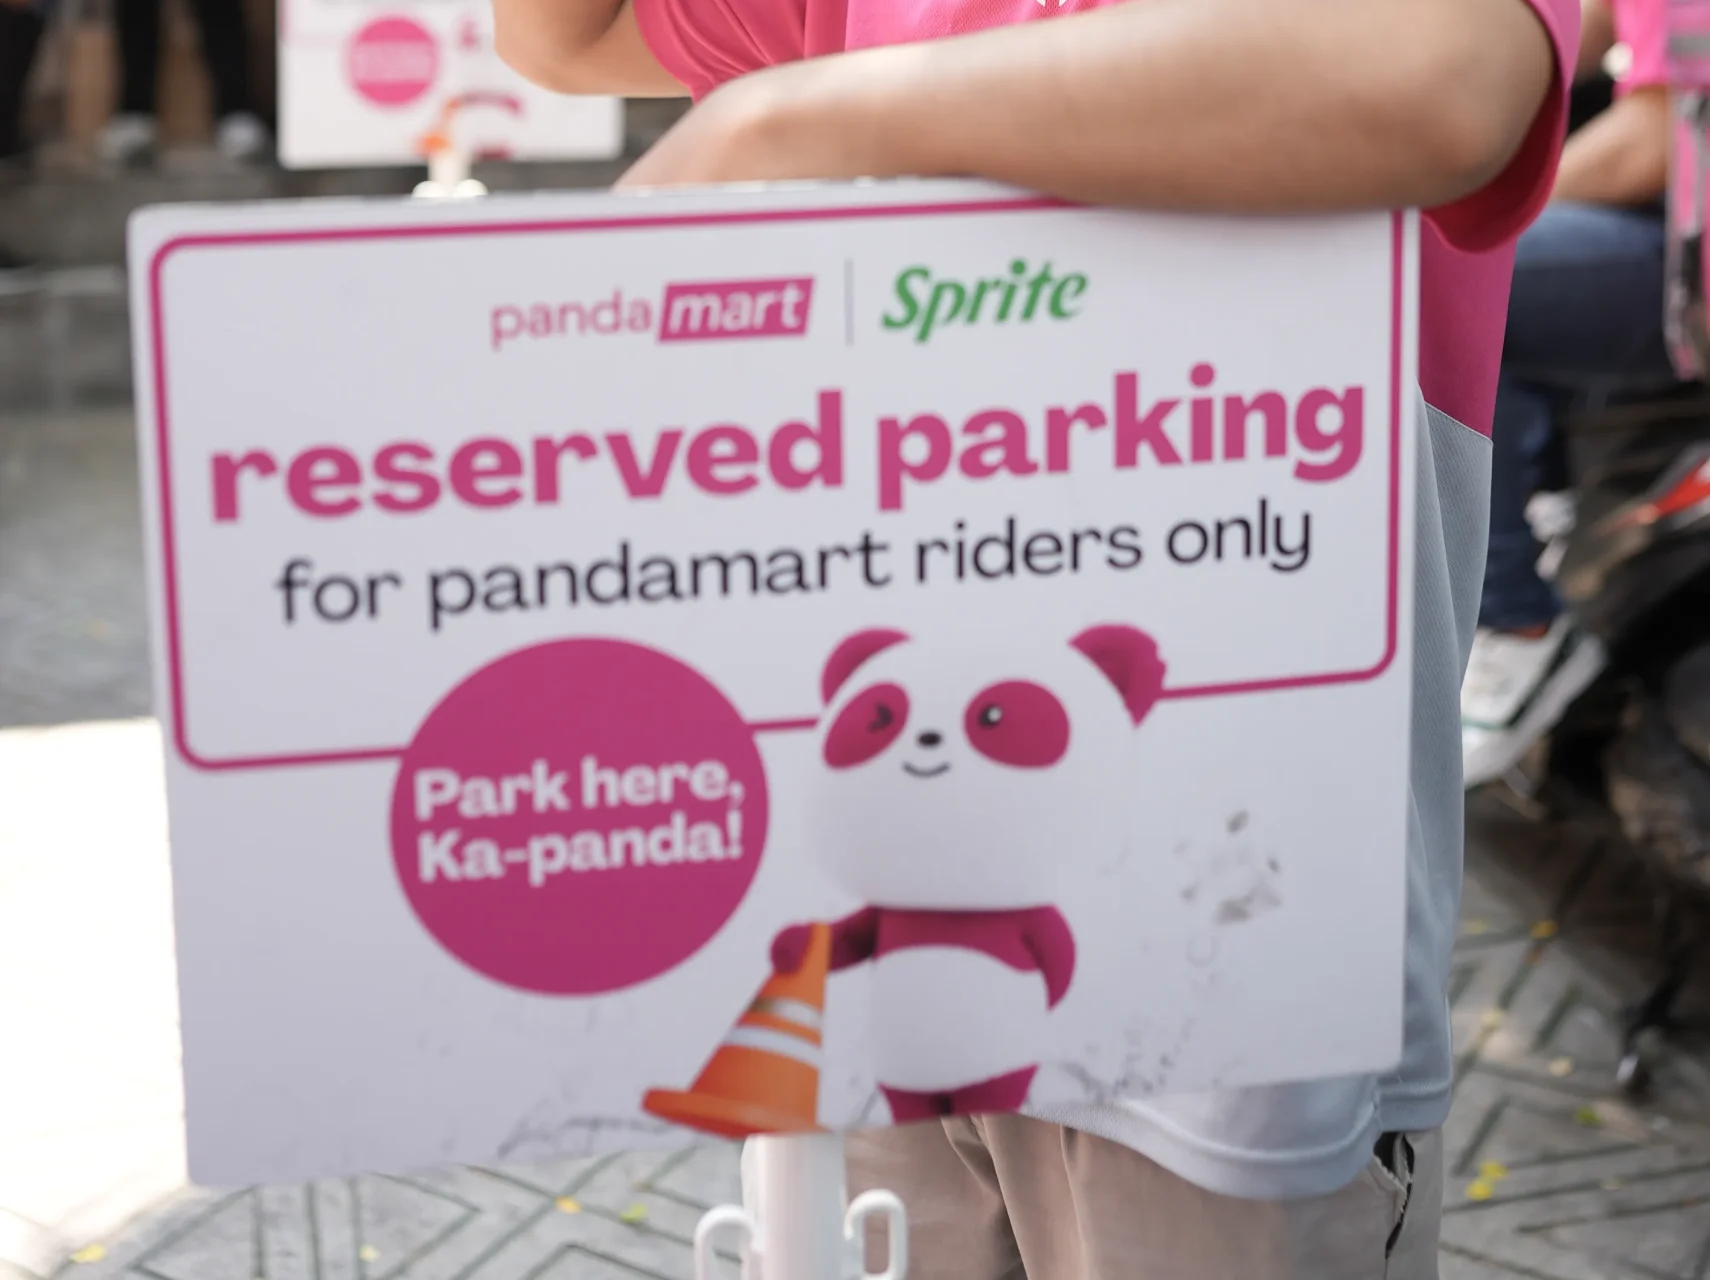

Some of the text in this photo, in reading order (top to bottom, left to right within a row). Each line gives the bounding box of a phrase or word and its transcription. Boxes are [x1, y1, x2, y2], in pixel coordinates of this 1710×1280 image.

[881, 258, 1089, 344] Sprite
[210, 362, 1365, 523] reserved parking
[273, 497, 1312, 634] for pandamart riders only
[413, 754, 746, 821] Park here,
[418, 809, 744, 888] Ka-panda!
